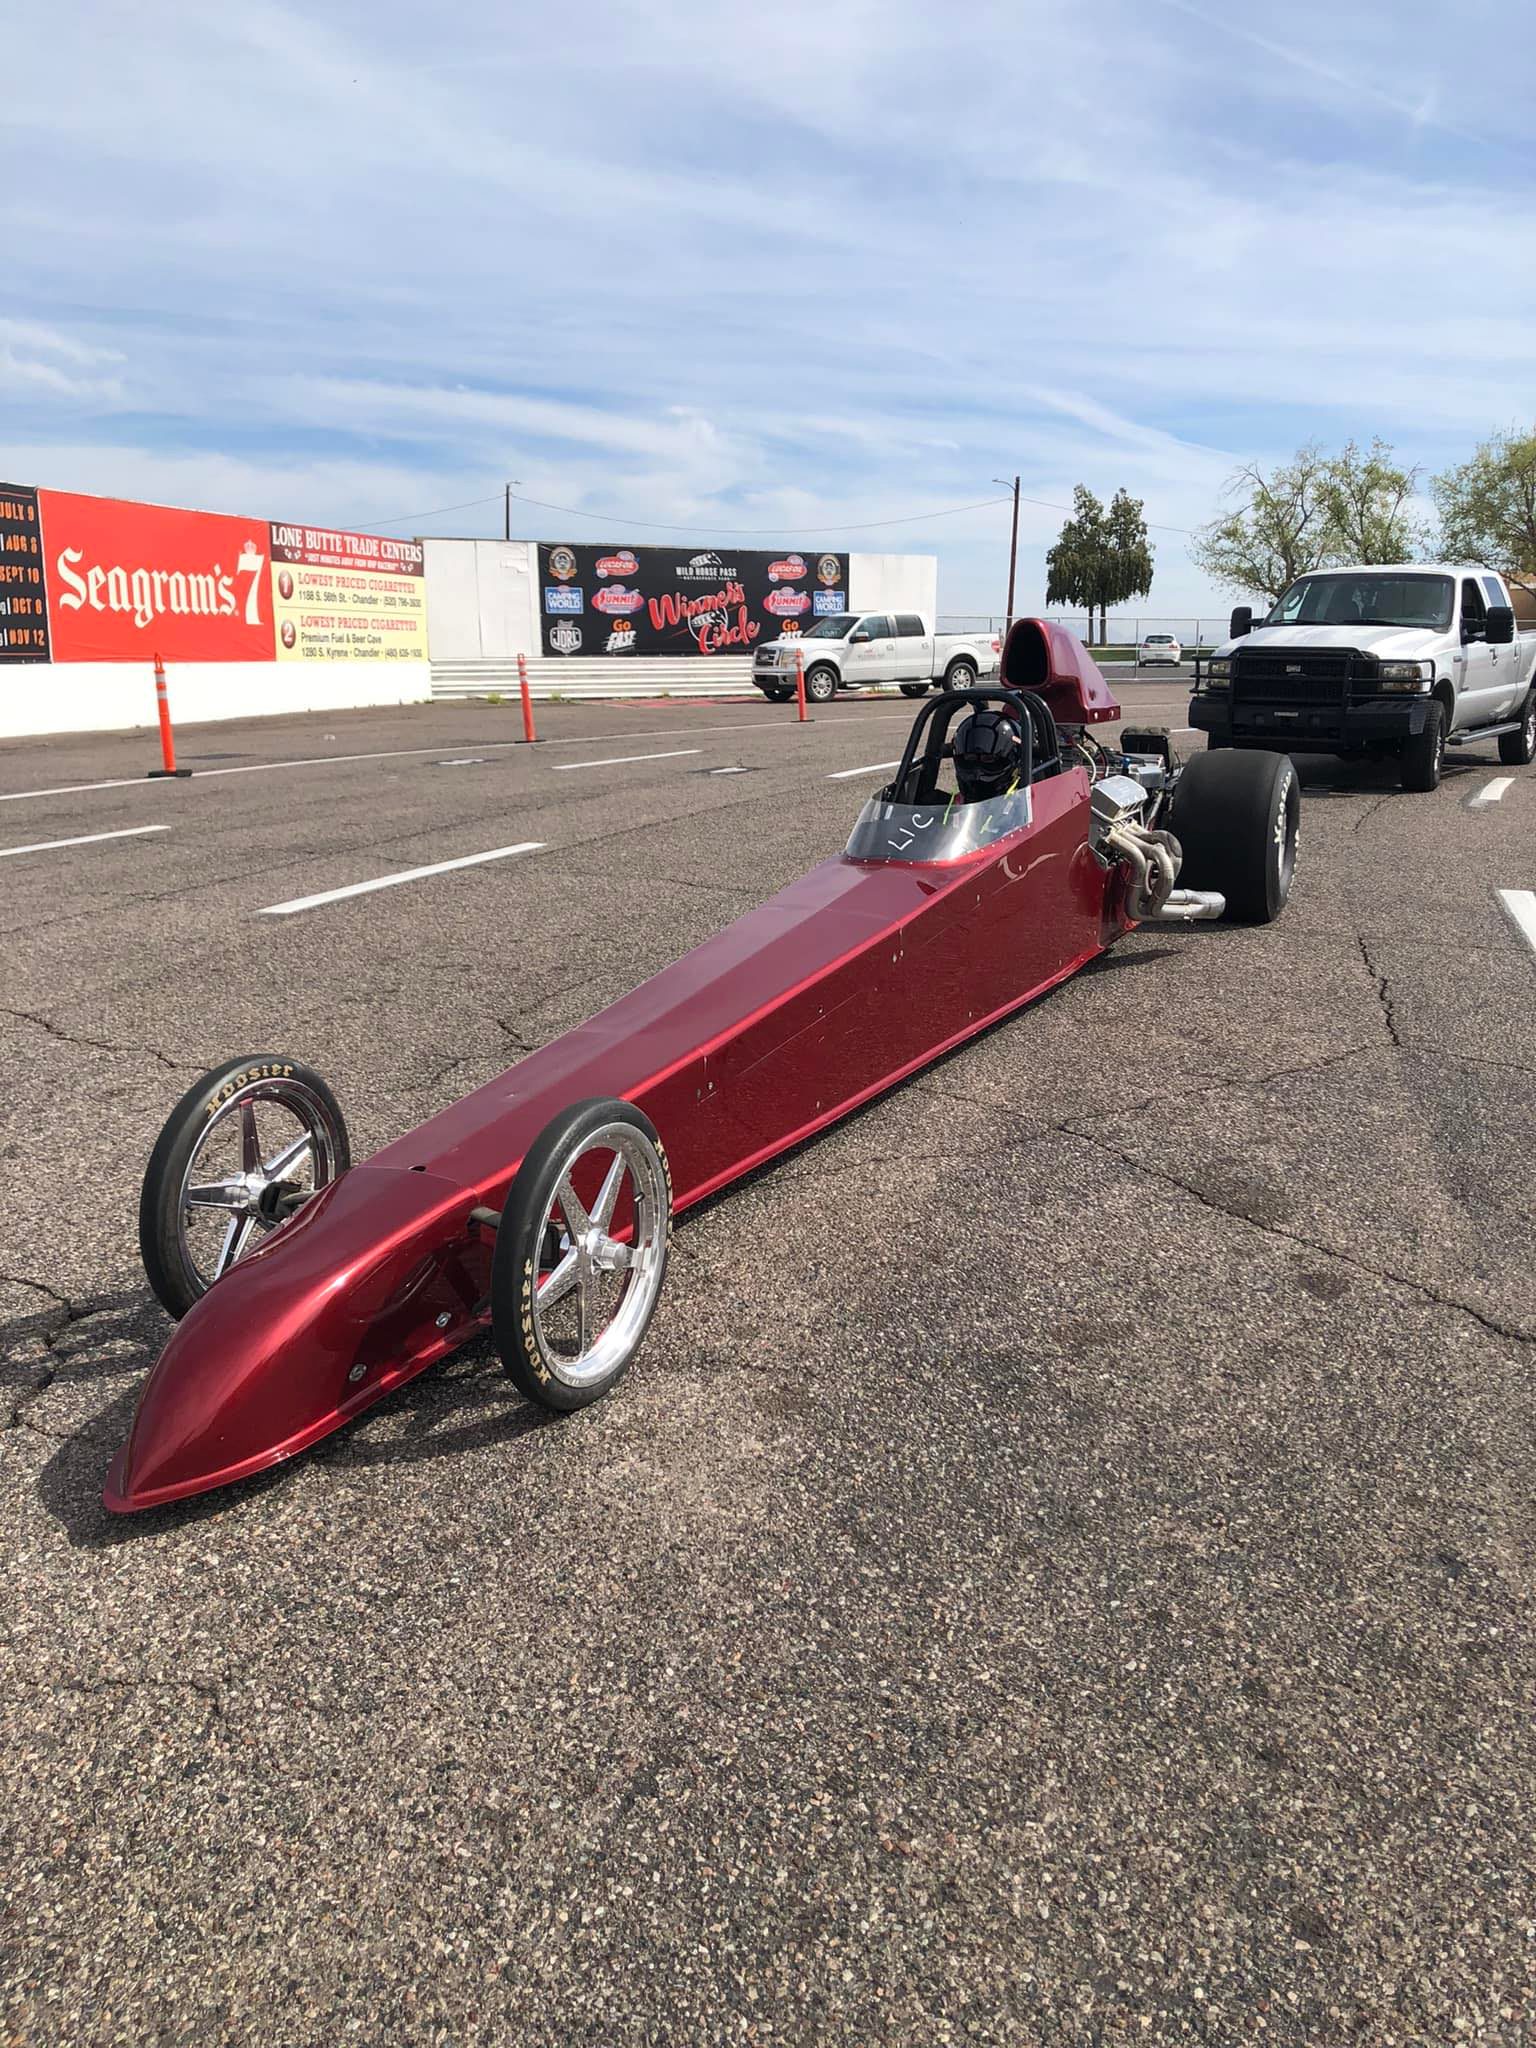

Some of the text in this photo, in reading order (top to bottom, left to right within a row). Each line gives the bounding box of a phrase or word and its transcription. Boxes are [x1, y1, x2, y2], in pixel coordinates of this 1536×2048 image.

[0, 501, 24, 521] JULY
[6, 534, 28, 552] AUG
[271, 525, 422, 562] LONE BUTTE TRADE CENTERS
[0, 565, 40, 585] SEPT 10
[298, 572, 334, 587] LOWEST
[335, 576, 366, 590] PRICED
[675, 567, 737, 577] WILD HORSE PASS
[56, 546, 236, 629] Seagram's
[237, 553, 265, 625] 7
[12, 597, 33, 615] OCT
[548, 600, 581, 609] WORLD
[648, 581, 746, 631] Winner's
[815, 602, 843, 611] WORLD
[300, 615, 335, 628] LOWEST
[338, 617, 369, 630] PRICED
[698, 604, 761, 655] Circle
[32, 629, 46, 647] 12
[301, 632, 330, 643] Premium
[331, 633, 345, 644] Fuel
[352, 633, 366, 644] Beer
[367, 634, 382, 645] Cave
